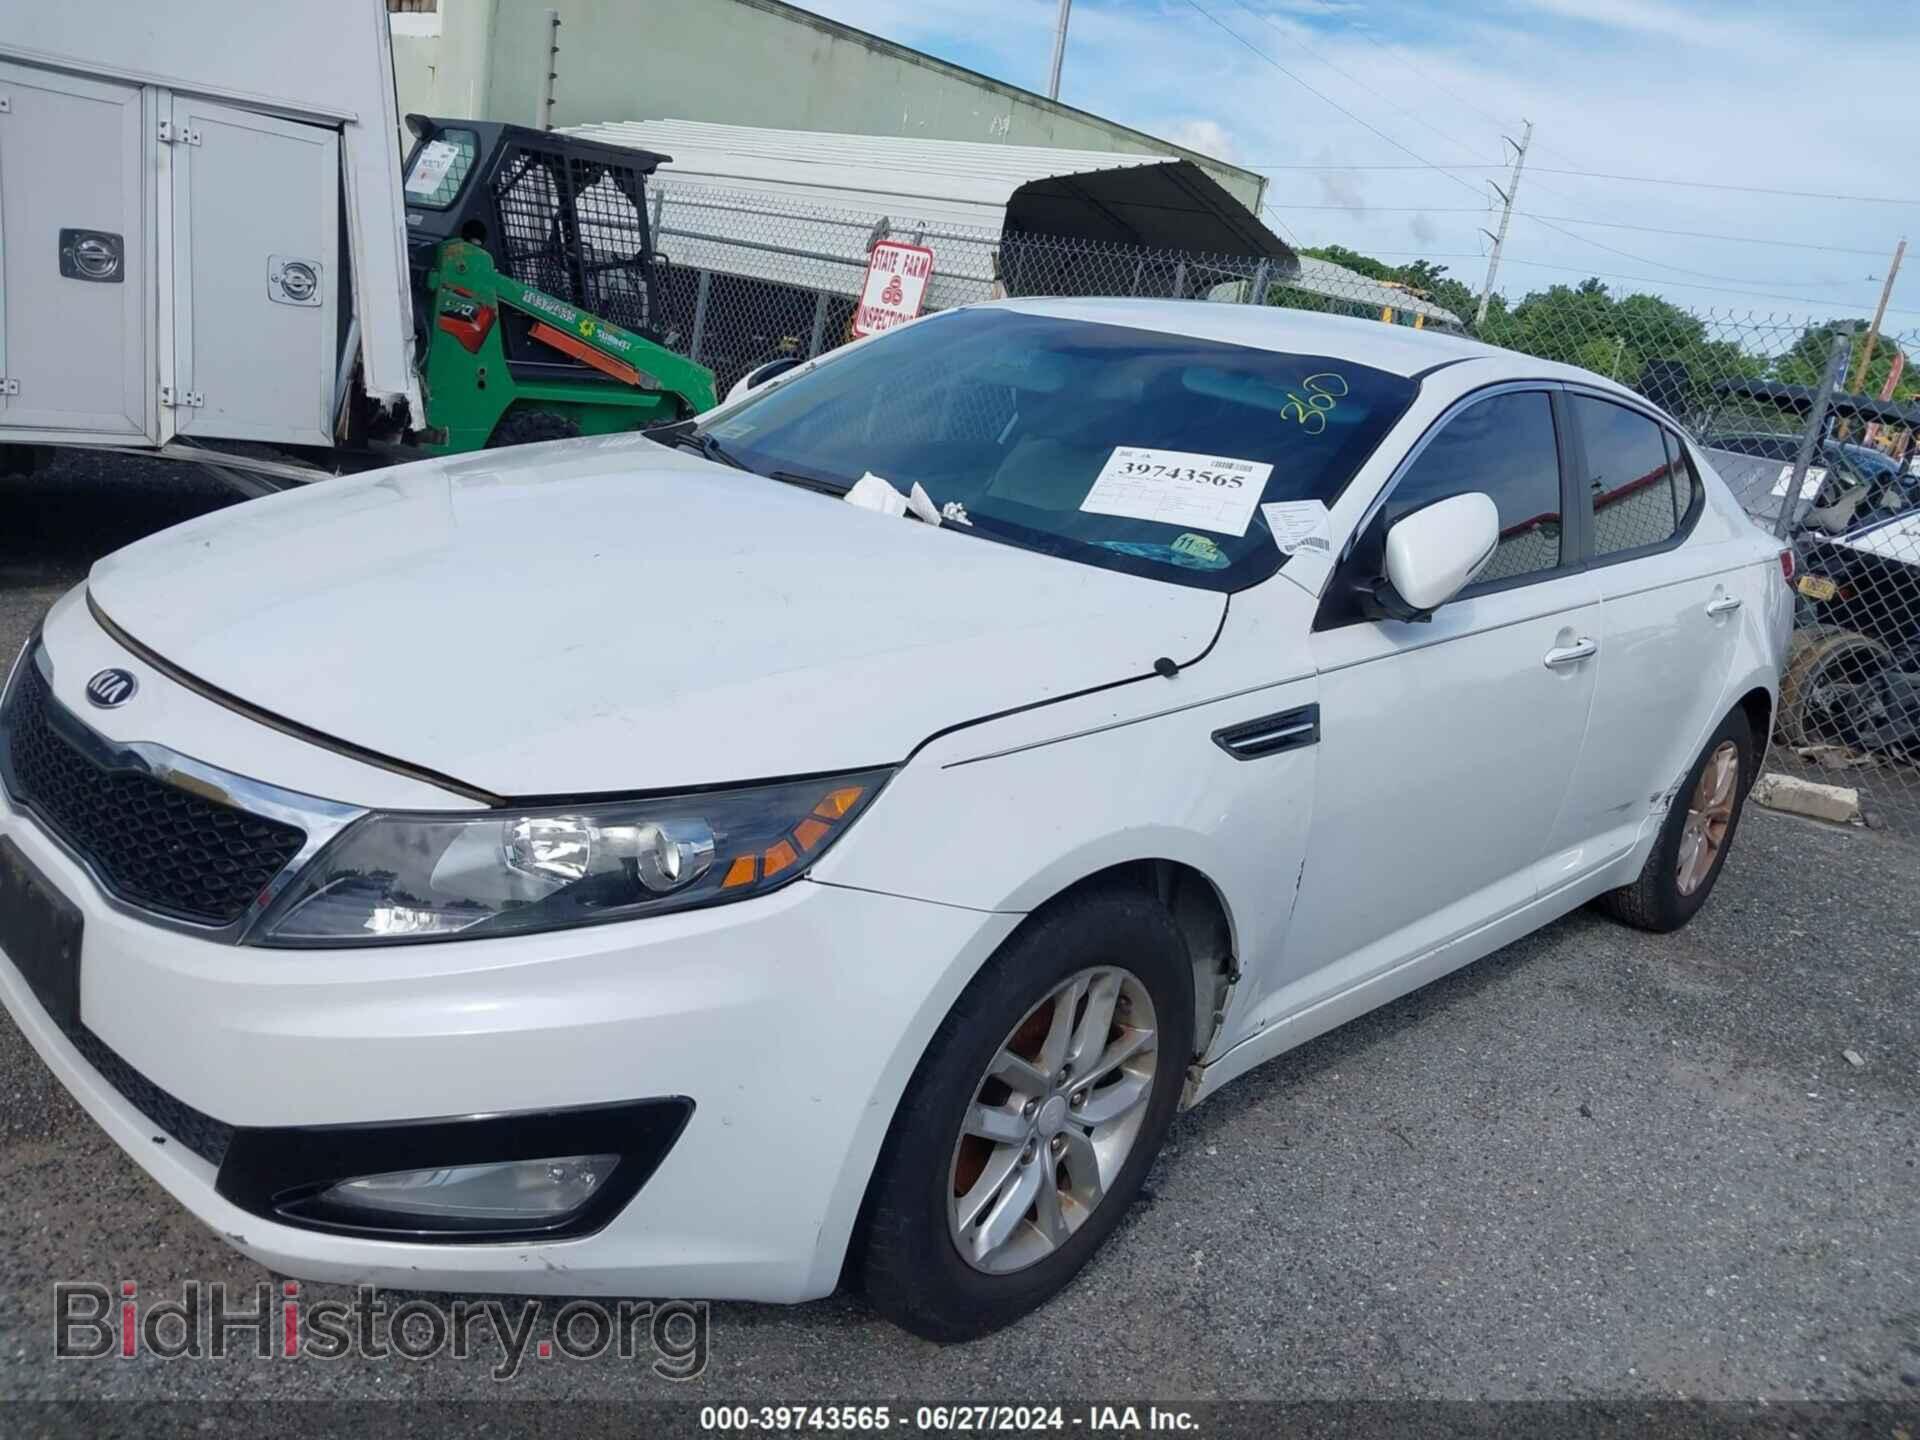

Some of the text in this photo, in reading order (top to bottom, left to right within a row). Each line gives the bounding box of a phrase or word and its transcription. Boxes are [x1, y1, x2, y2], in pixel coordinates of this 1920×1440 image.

[872, 249, 930, 278] STATE FARM
[860, 305, 915, 331] INSPECTION
[1118, 461, 1246, 489] 39743565
